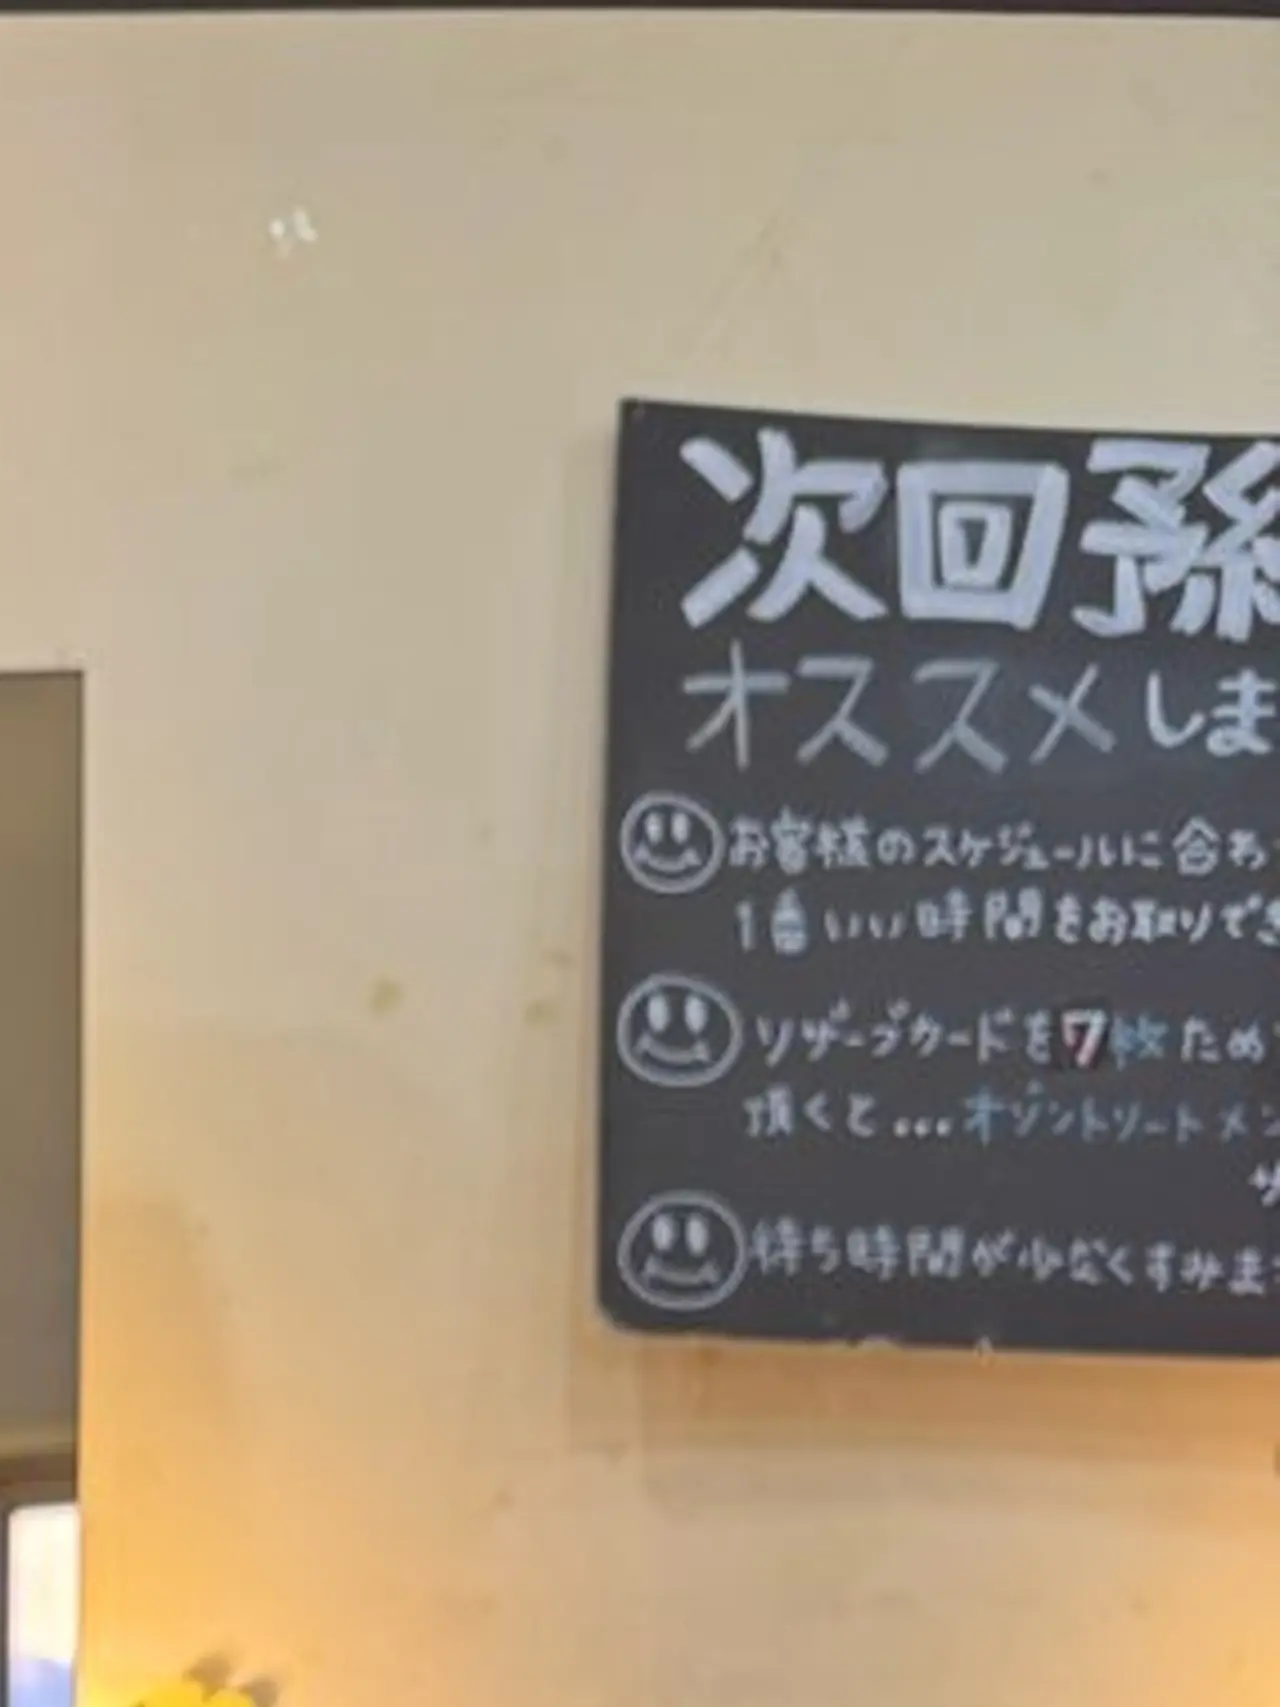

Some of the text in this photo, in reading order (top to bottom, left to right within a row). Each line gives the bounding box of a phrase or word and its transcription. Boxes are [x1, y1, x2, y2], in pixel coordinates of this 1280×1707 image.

[682, 638, 1276, 770] オススメしま
[728, 804, 1280, 876] お客様のスケジュールに合わ
[755, 997, 1280, 1070] リザーブカードを7枚ため
[749, 1214, 1280, 1298] 待ち時間が少なくすみま
